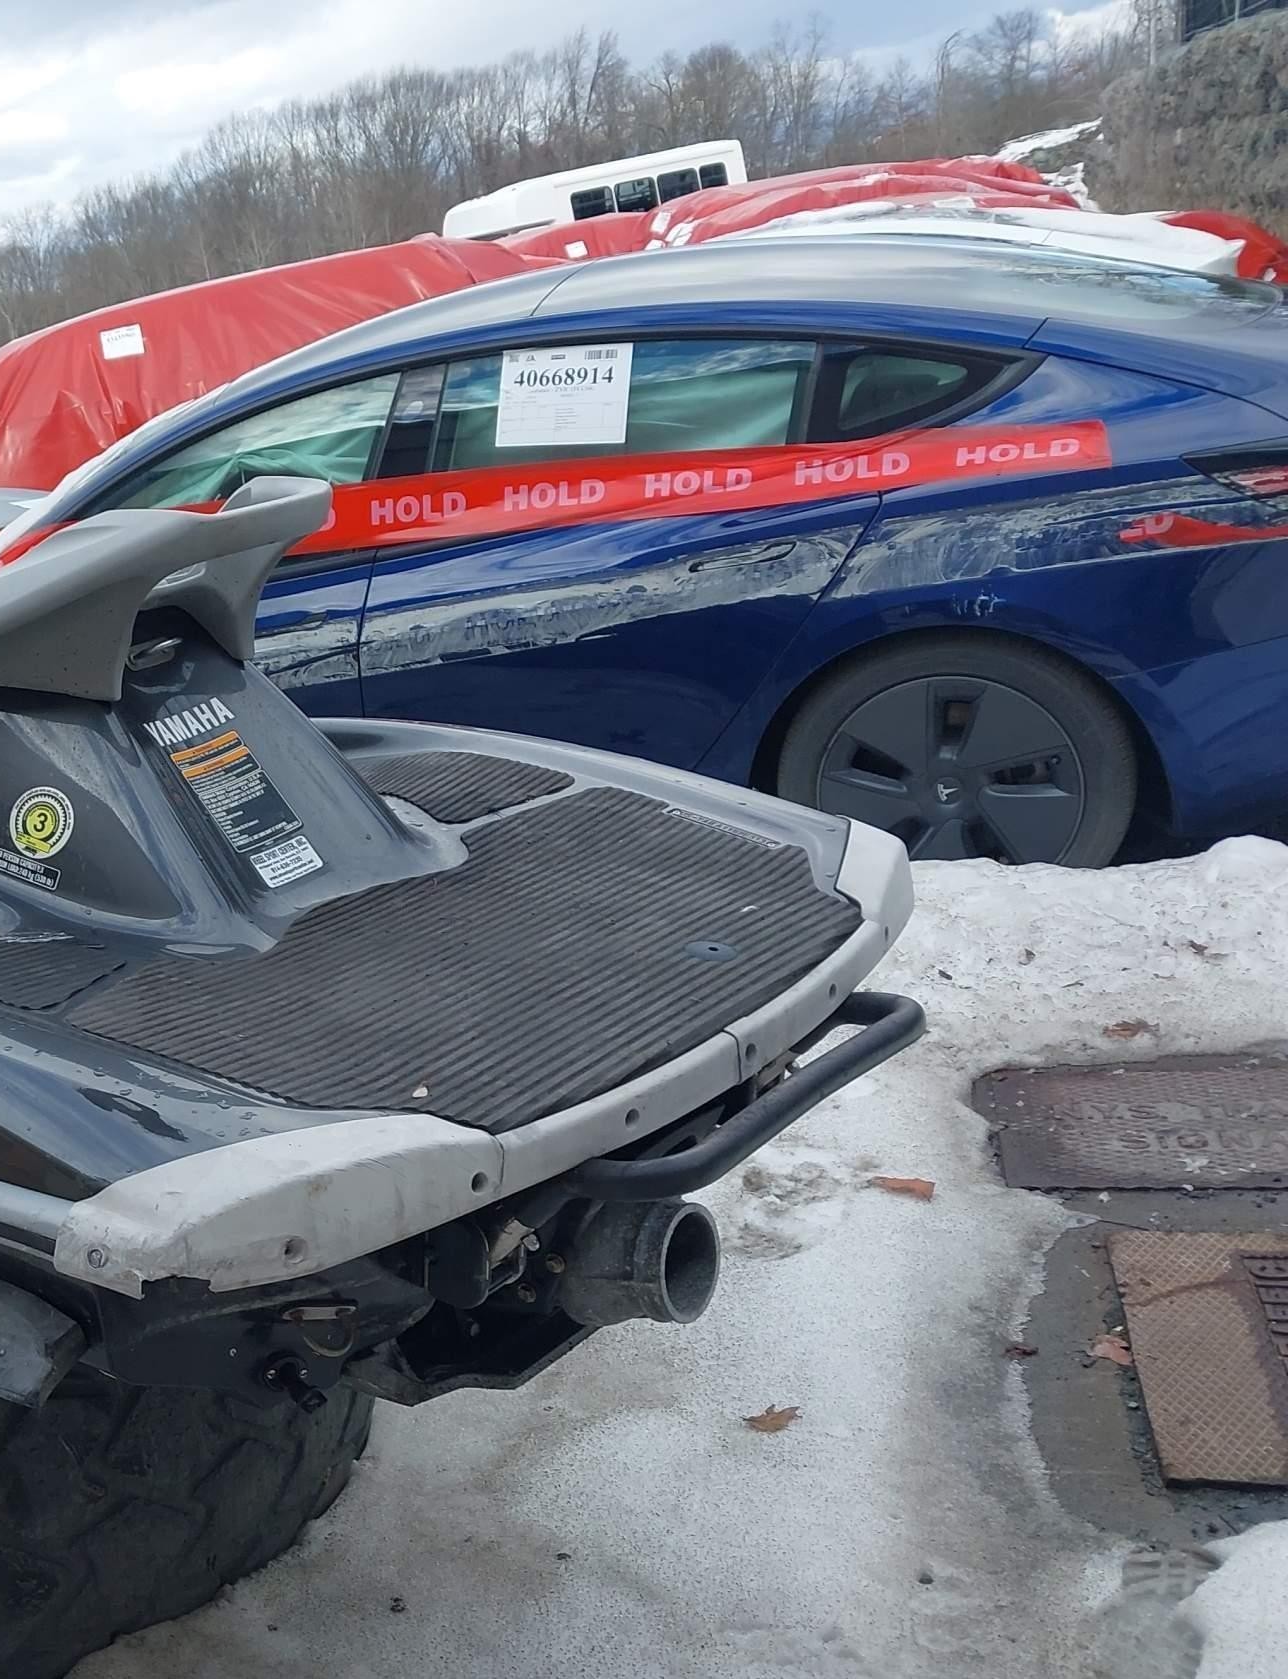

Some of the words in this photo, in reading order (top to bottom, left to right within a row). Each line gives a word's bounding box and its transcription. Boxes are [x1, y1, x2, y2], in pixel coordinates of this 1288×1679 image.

[513, 365, 614, 387] 40668914
[370, 491, 467, 526] HOLD
[503, 478, 606, 512] HOLD
[644, 467, 753, 499] HOLD
[794, 452, 911, 486] HOLD
[955, 438, 1082, 467] HOLD
[142, 696, 236, 747] YAMAHA
[33, 812, 48, 833] 3
